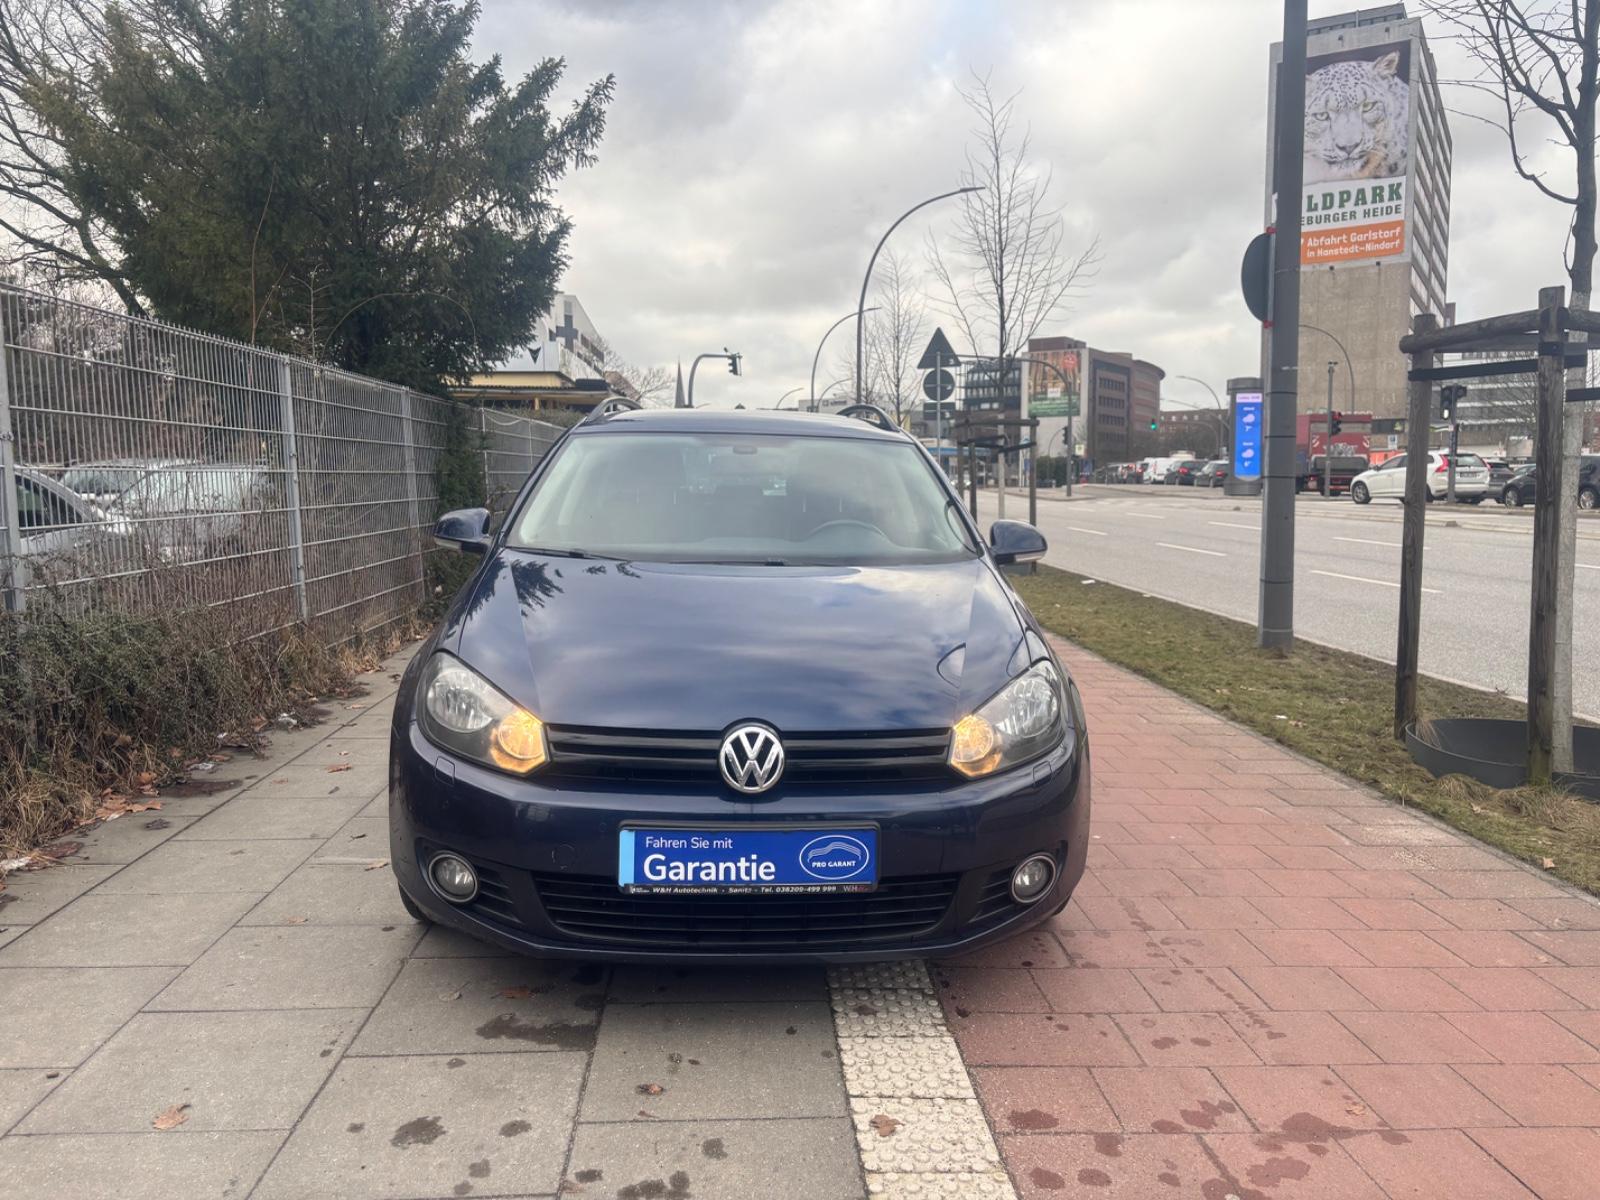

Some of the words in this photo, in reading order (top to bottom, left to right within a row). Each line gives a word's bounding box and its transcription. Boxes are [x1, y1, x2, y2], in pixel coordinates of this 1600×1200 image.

[1363, 203, 1402, 219] HEIDE
[1307, 234, 1348, 247] Abfahrt
[1350, 226, 1401, 242] Garlstorf
[645, 836, 687, 849] Fahren
[690, 837, 710, 849] Sie
[713, 837, 733, 849] mit
[643, 853, 776, 881] Garantie
[828, 860, 857, 868] GARANT
